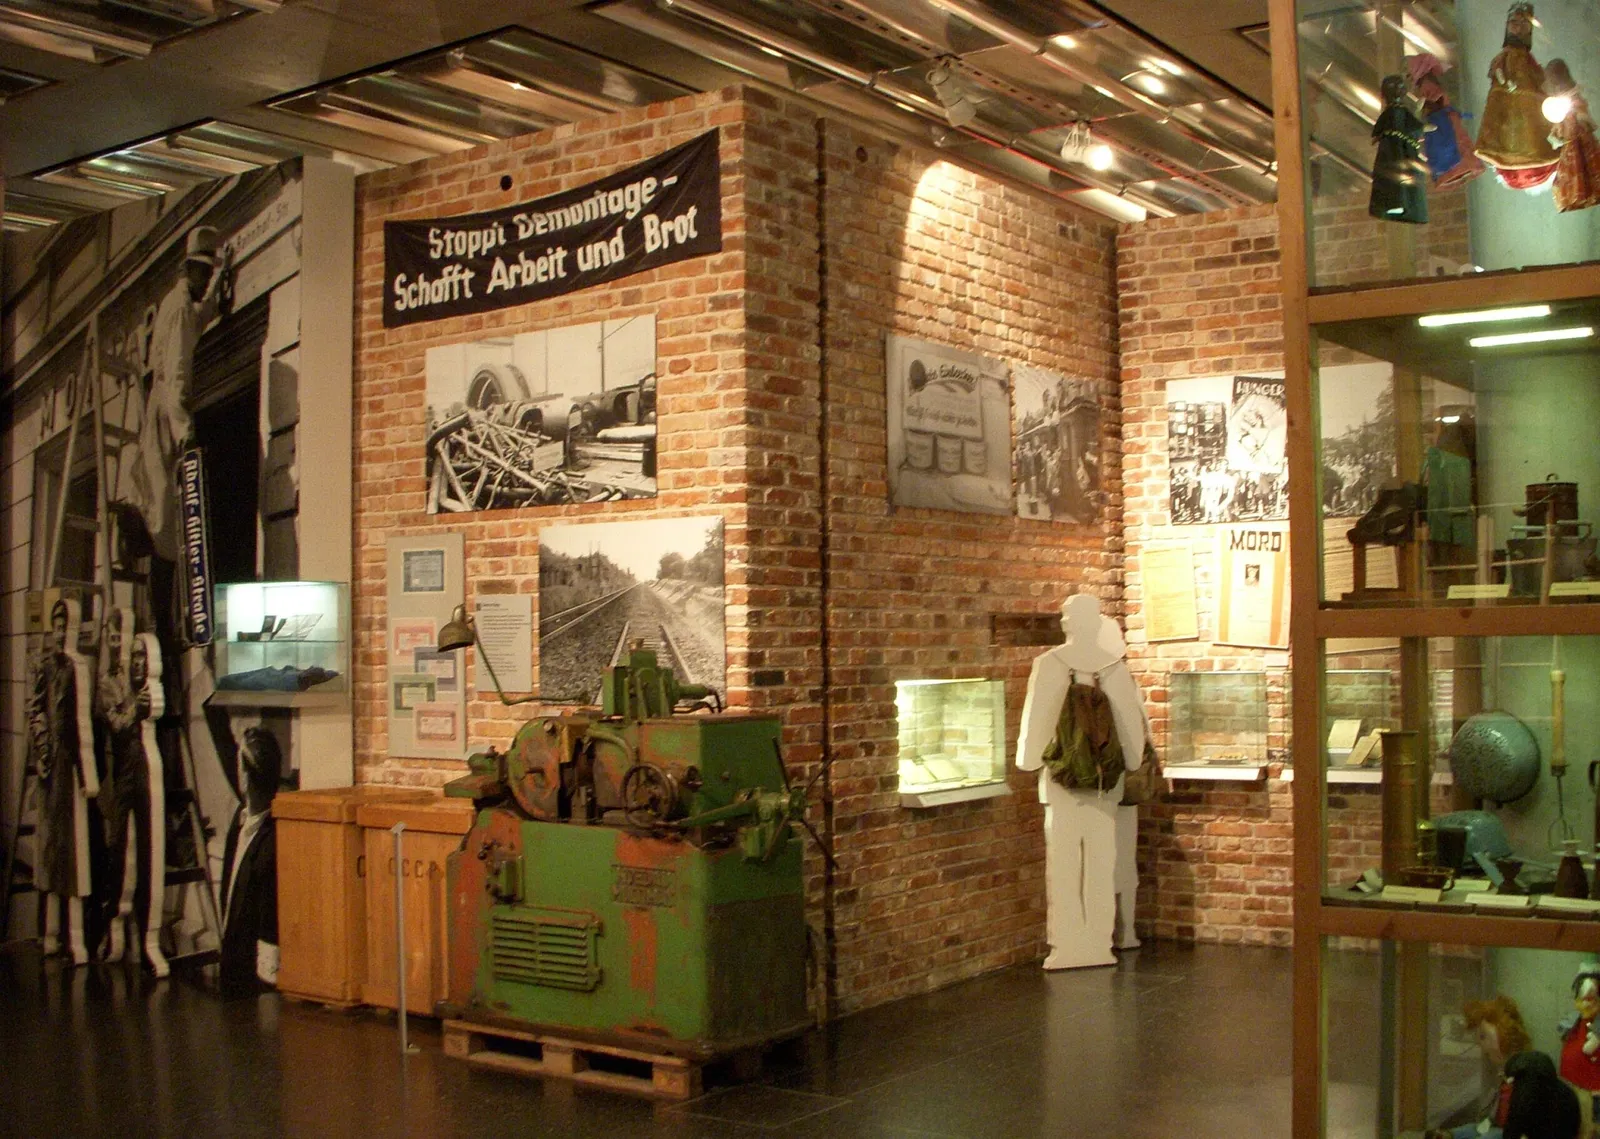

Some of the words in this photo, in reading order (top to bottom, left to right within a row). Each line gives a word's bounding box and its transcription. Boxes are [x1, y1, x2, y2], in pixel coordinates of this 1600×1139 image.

[393, 264, 475, 312] Schafft
[486, 246, 568, 295] Arbeit
[576, 226, 626, 273] und
[643, 204, 699, 254] Brot
[1229, 529, 1282, 552] MORD
